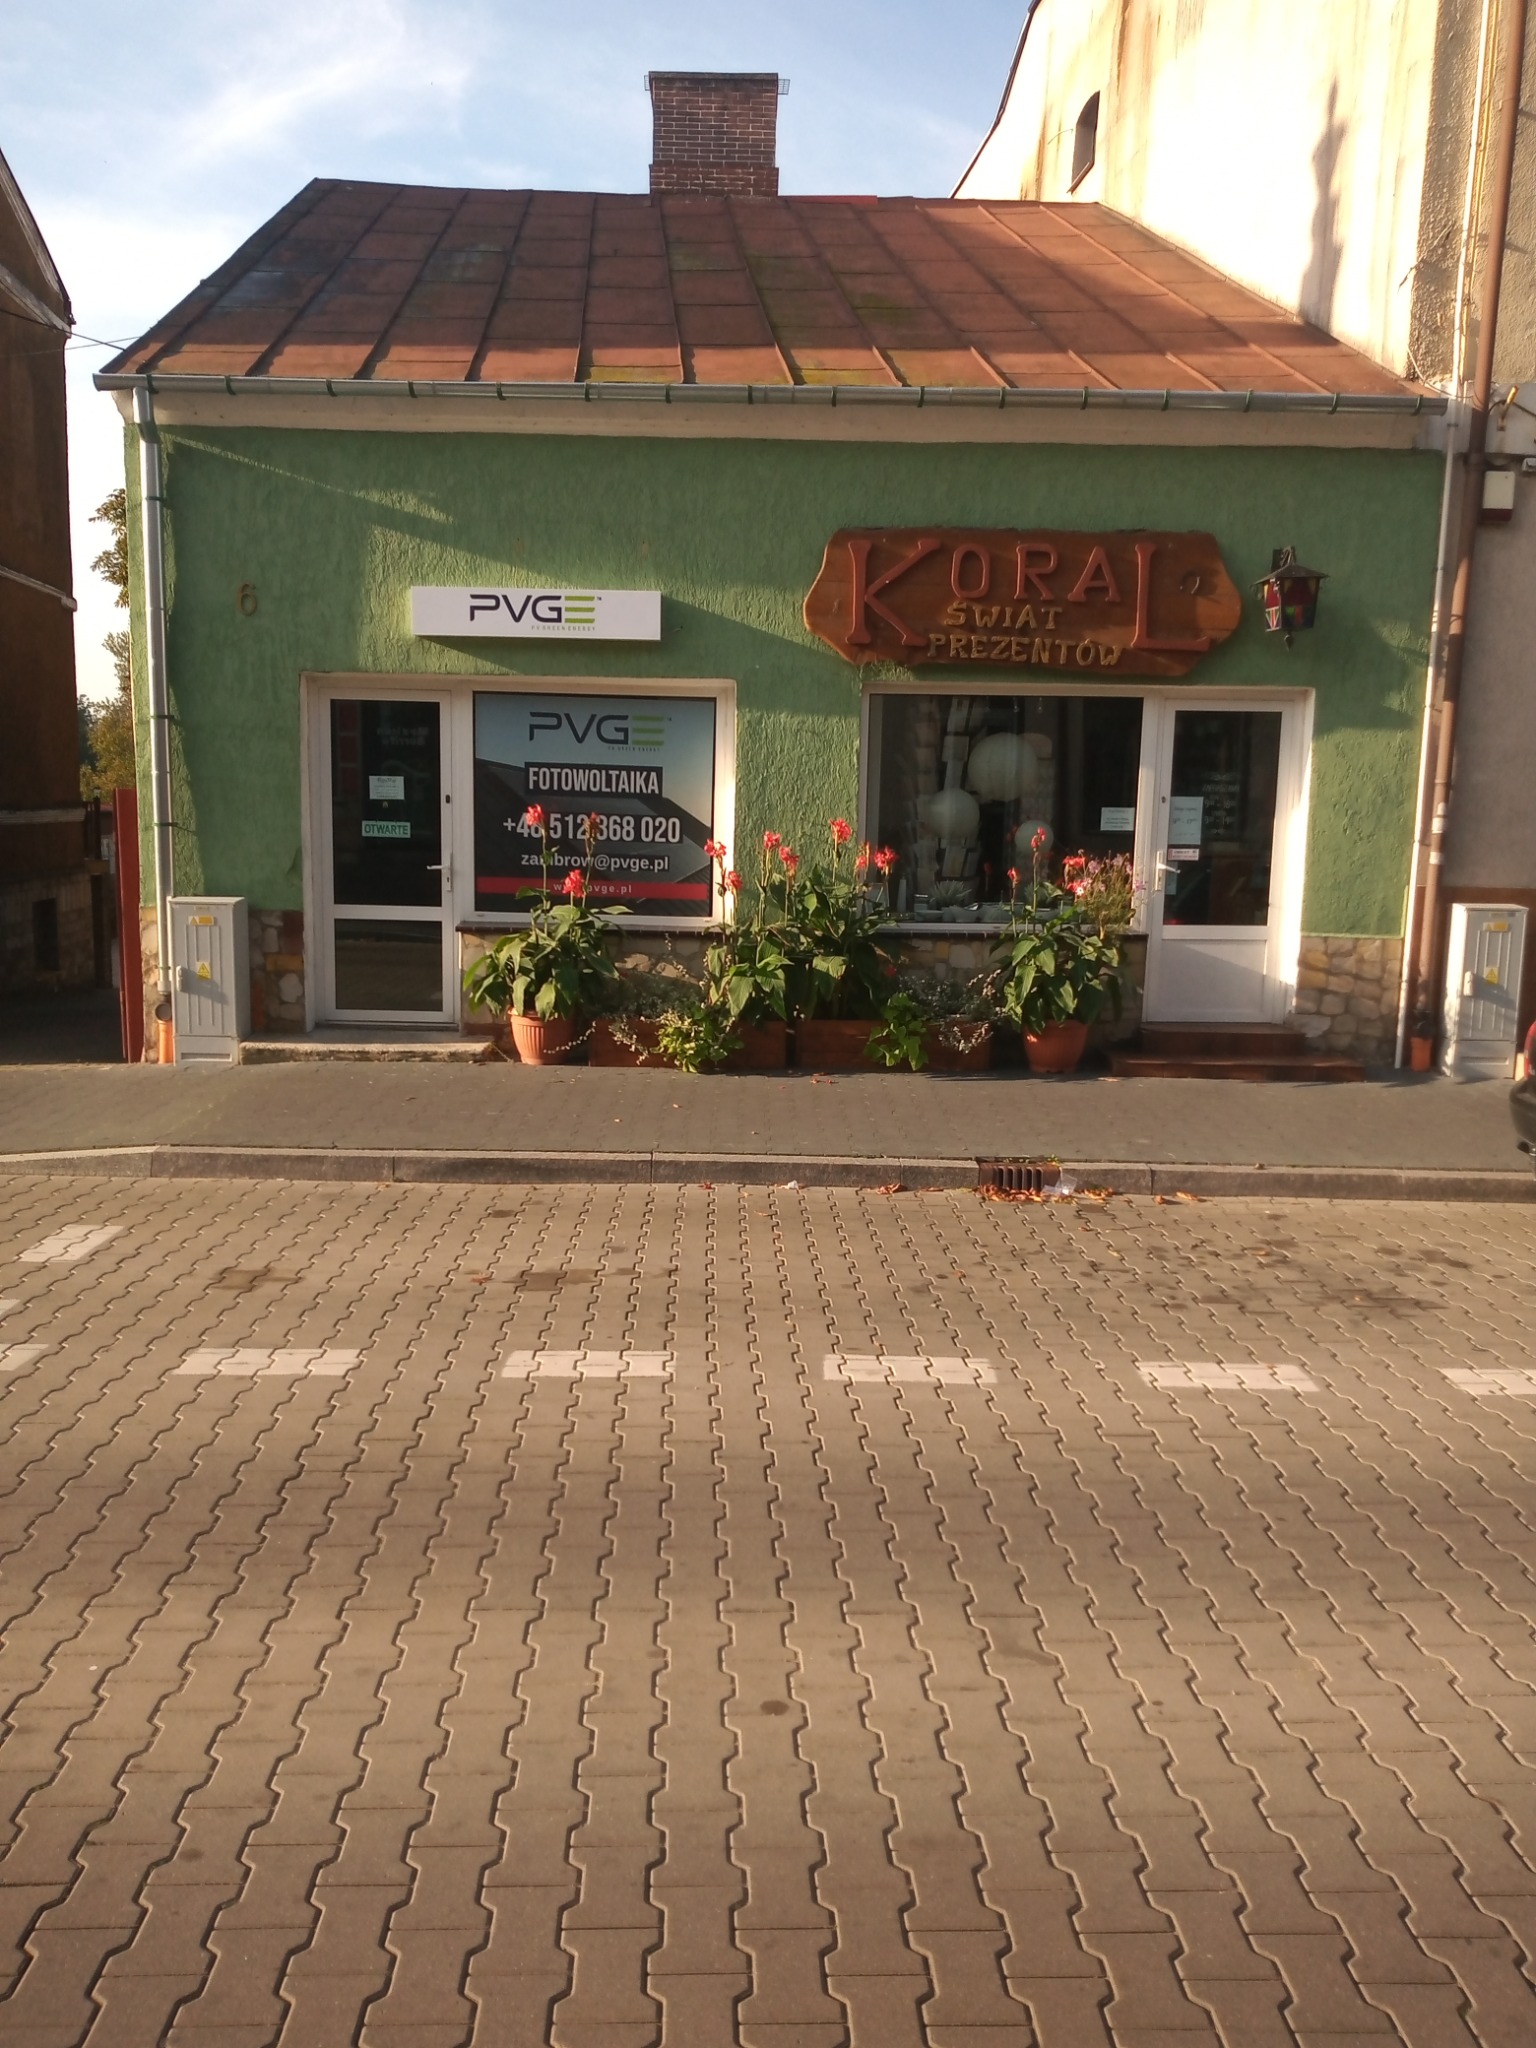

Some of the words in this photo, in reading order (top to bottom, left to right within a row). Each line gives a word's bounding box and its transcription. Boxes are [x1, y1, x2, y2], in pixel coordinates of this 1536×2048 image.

[236, 582, 258, 617] 6
[470, 594, 595, 623] PVGE
[845, 538, 1211, 651] KORAL
[944, 601, 1063, 630] ŚWIAT
[927, 632, 1126, 666] PREZENTÓW
[529, 712, 665, 746] PVGE
[529, 767, 660, 794] FOTOWOLTAIKA
[364, 824, 409, 835] OTWARTE
[596, 815, 635, 841] 368
[641, 816, 681, 843] 020
[521, 853, 669, 873] zabrow@pvge.pl
